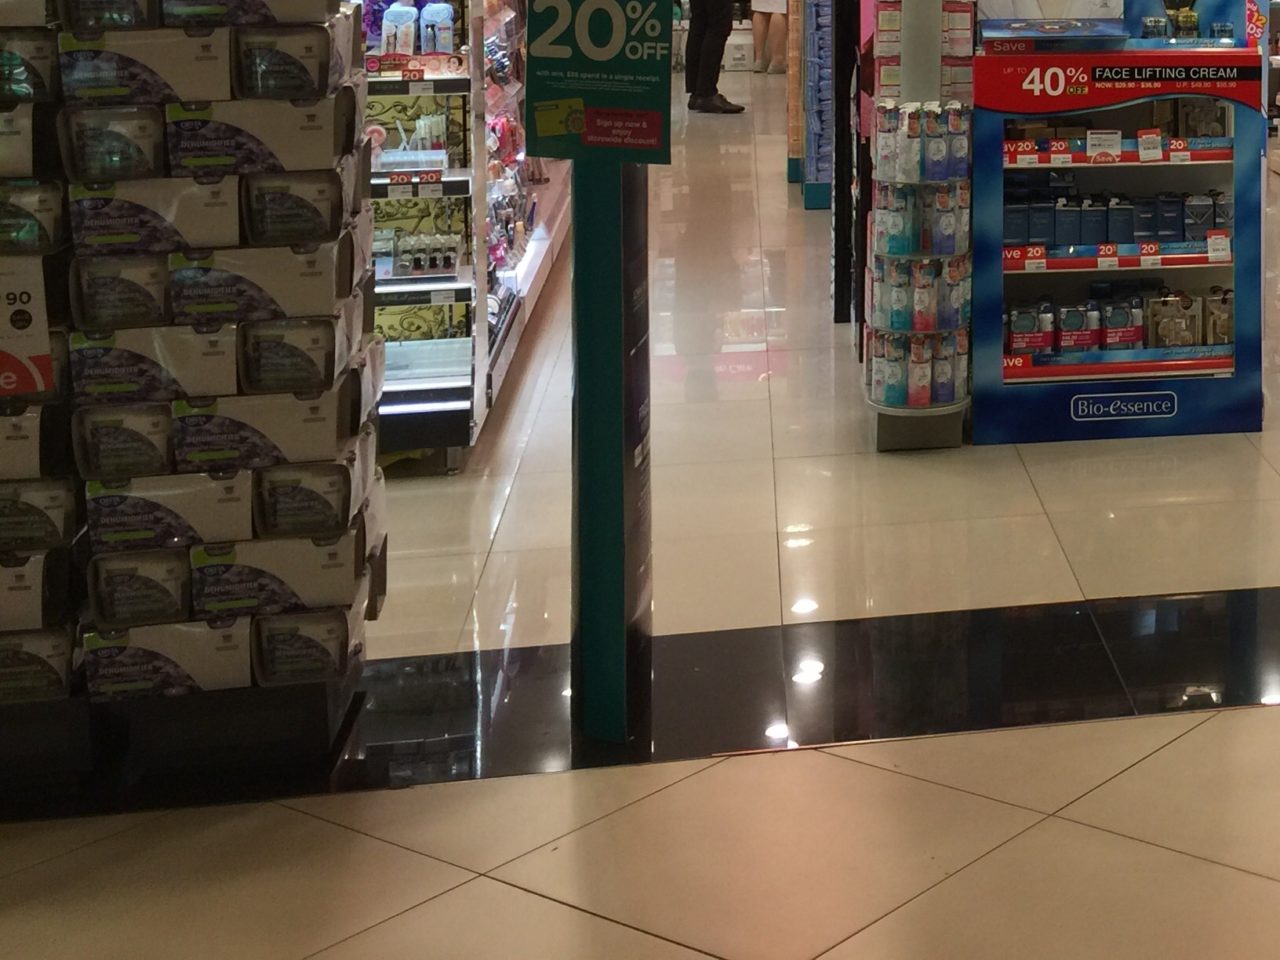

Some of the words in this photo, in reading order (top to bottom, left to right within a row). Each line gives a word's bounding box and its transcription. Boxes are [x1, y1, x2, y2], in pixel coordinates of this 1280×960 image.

[625, 41, 669, 60] OFF
[993, 40, 1026, 52] Save
[1003, 67, 1014, 75] UP
[1022, 67, 1088, 96] 40%
[1095, 67, 1130, 79] FACE
[1134, 67, 1186, 79] LIFTING
[1189, 67, 1238, 79] CREAM
[5, 290, 32, 306] 90
[1077, 397, 1172, 416] Bio-essence
